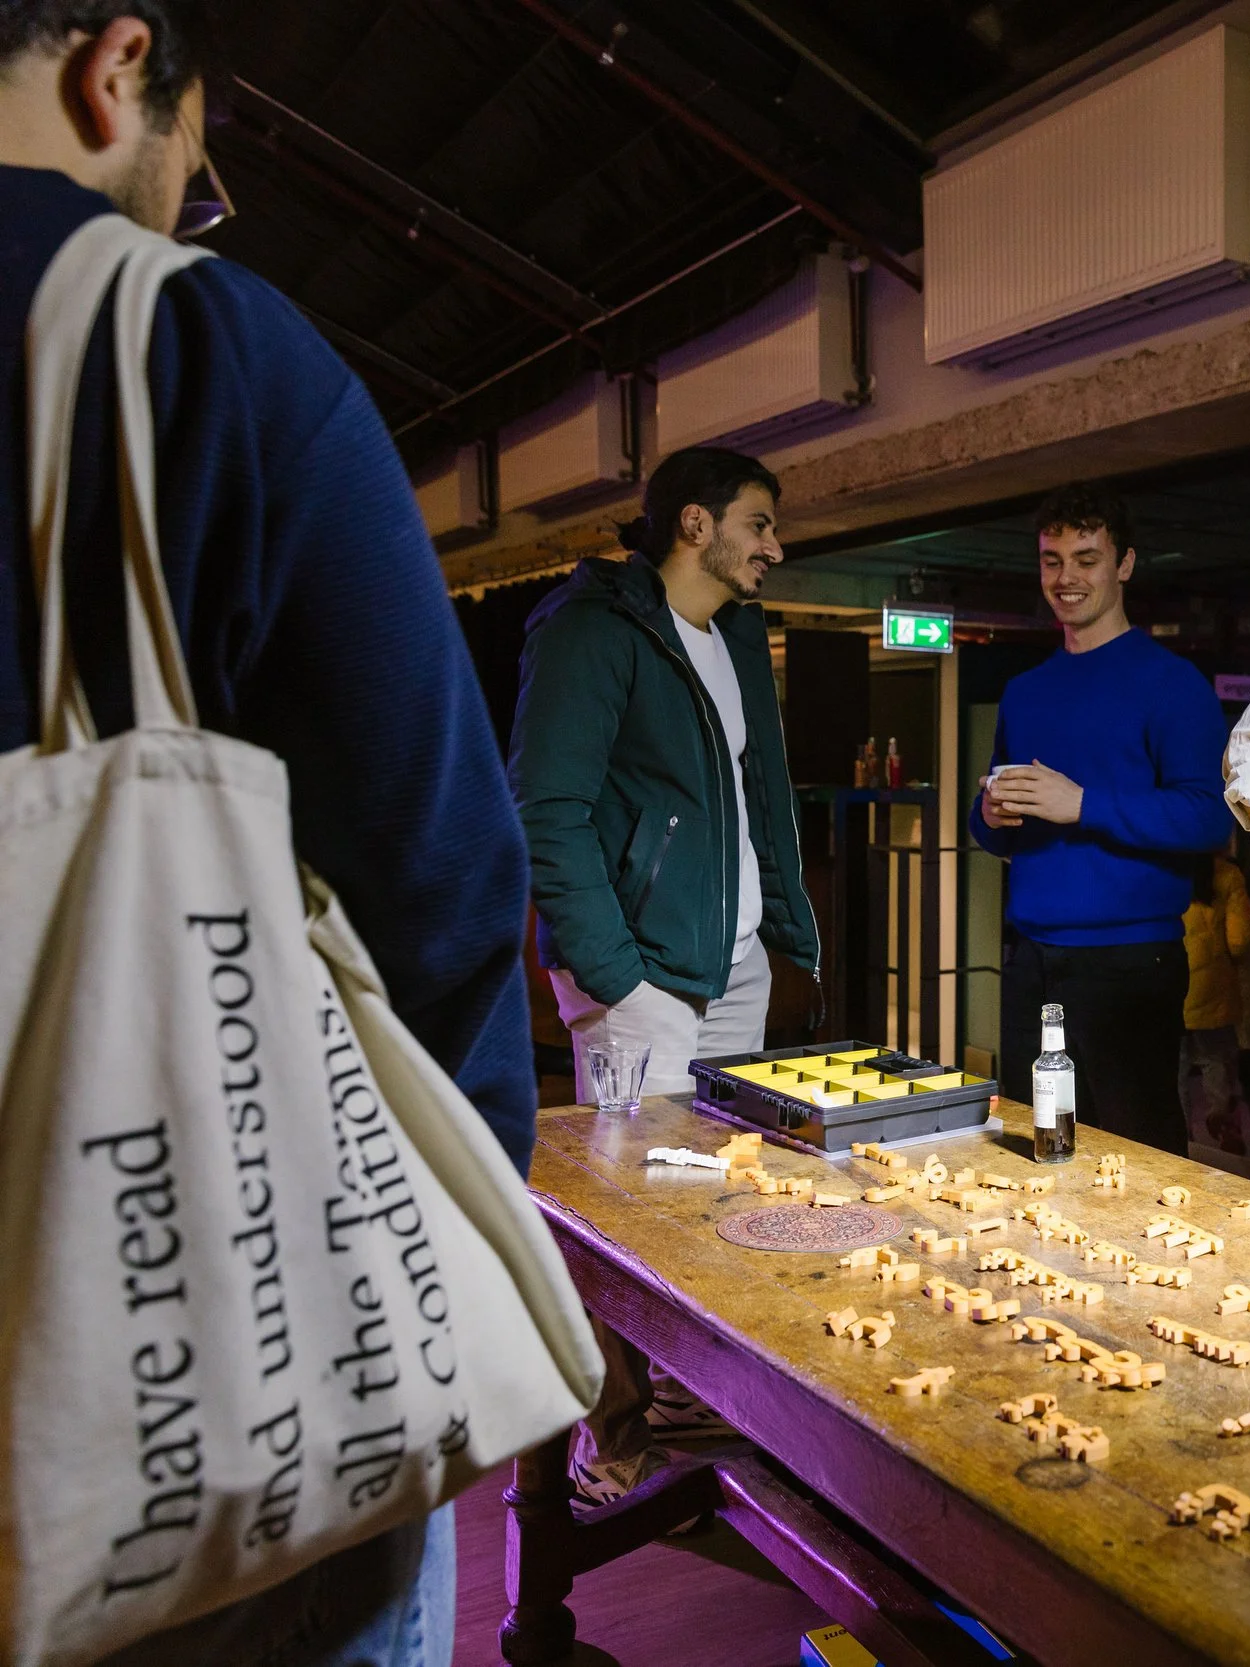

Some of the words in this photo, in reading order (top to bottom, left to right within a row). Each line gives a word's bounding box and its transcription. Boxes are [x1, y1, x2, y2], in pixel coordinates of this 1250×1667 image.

[80, 1118, 189, 1315] read
[185, 908, 293, 1381] understood
[332, 1275, 400, 1405] the
[113, 1338, 205, 1552] have
[246, 1401, 304, 1550] and
[334, 1419, 406, 1510] all
